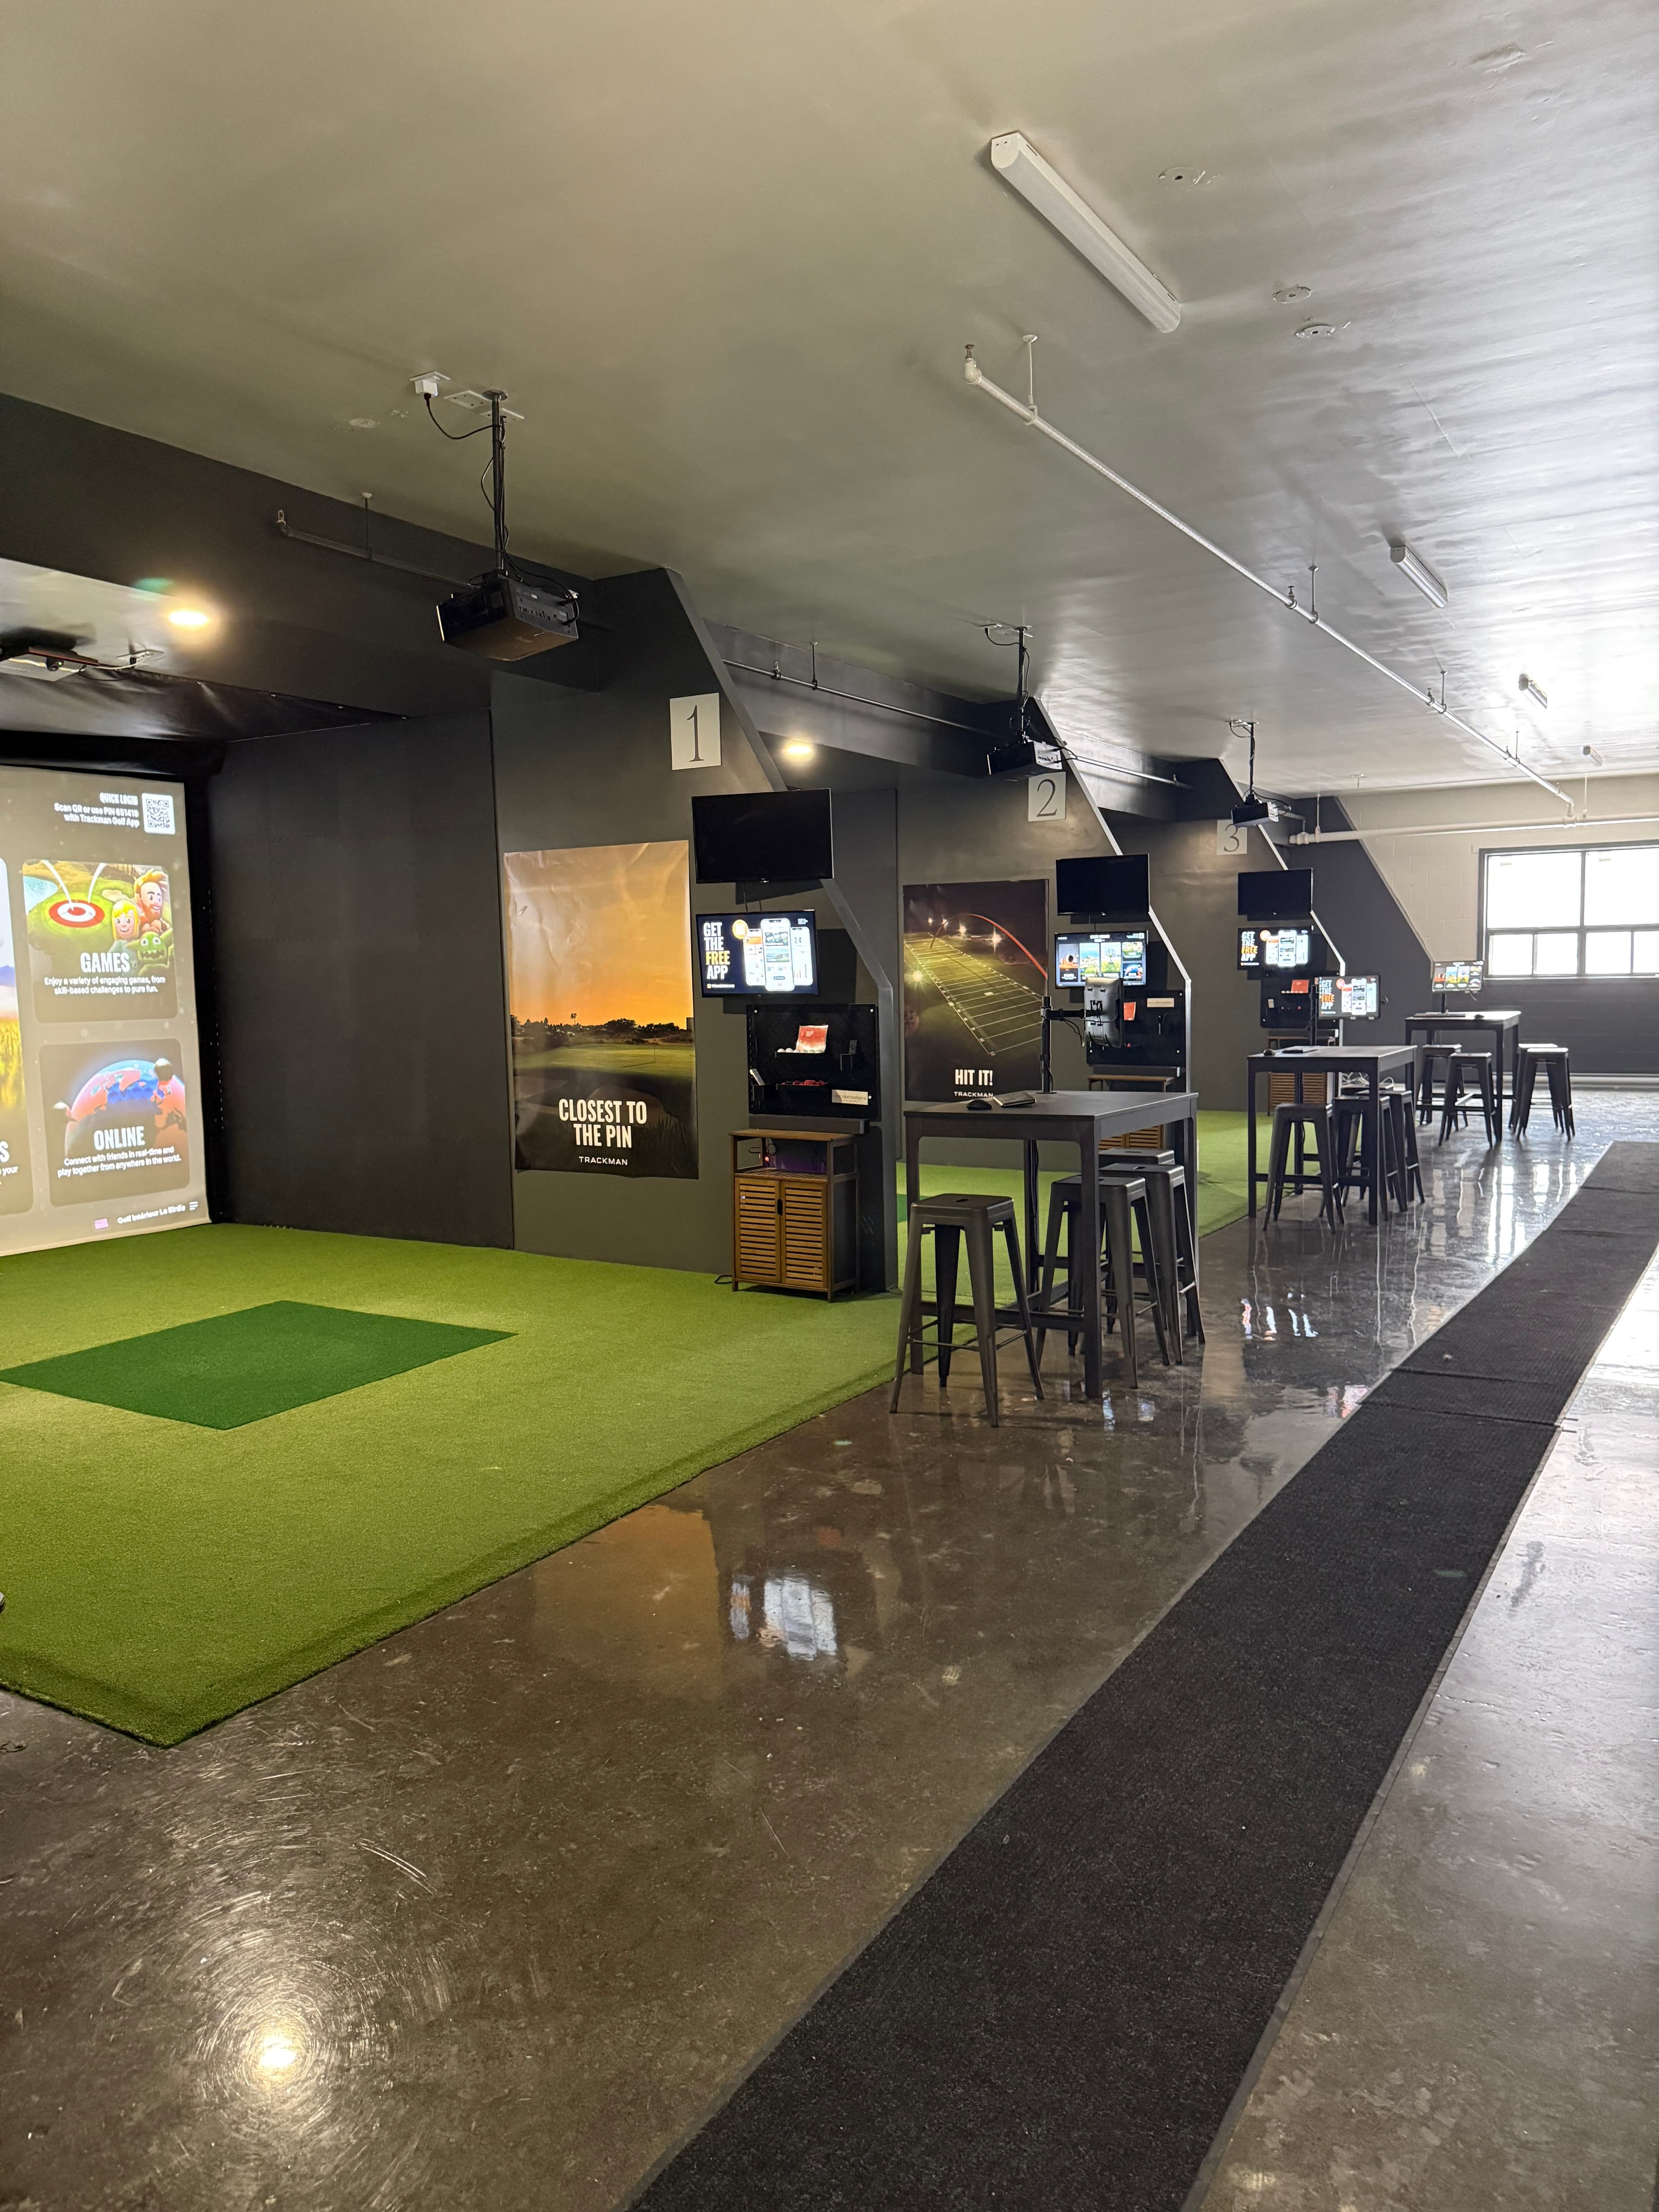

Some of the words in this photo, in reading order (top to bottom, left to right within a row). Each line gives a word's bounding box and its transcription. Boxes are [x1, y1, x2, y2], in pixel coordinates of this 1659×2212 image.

[686, 705, 704, 762] 1
[100, 792, 119, 804] QUICK
[120, 795, 138, 805] LOGIN
[1036, 779, 1057, 817] 2
[54, 803, 71, 812] Scan
[72, 804, 83, 813] QR
[83, 806, 91, 814] or
[91, 807, 103, 815] use
[104, 807, 115, 816] PIN
[64, 813, 79, 822] with
[80, 814, 112, 824] Trackman
[112, 816, 126, 826] Golf
[126, 819, 140, 828] App
[1224, 824, 1239, 852] 3
[703, 922, 723, 937] GET
[704, 936, 724, 951] THE
[80, 952, 130, 973] GAMES
[706, 951, 731, 965] FREE
[706, 965, 728, 979] APP
[44, 977, 62, 987] Enjoy
[69, 976, 91, 986] variety
[92, 976, 99, 984] of
[99, 976, 128, 985] engaging
[129, 976, 151, 985] games,
[151, 975, 166, 983] from
[54, 986, 90, 995] skill-based
[90, 986, 123, 995] challenges
[1321, 994, 1335, 1002] FREE
[1321, 1001, 1334, 1010] APP
[955, 1069, 975, 1085] HIT
[979, 1070, 993, 1086] IT!
[559, 1099, 622, 1123] CLOSEST
[626, 1101, 647, 1124] TO
[94, 1126, 145, 1150] ONLINE
[573, 1123, 602, 1147] THE
[606, 1125, 632, 1148] PIN
[64, 1157, 92, 1166] Connect
[92, 1154, 106, 1162] with
[106, 1152, 128, 1161] friends
[135, 1148, 162, 1157] real-time
[162, 1145, 175, 1154] and
[578, 1156, 628, 1166] TRACKMAN
[2, 1166, 19, 1176] your
[57, 1168, 72, 1178] play
[72, 1165, 100, 1176] together
[100, 1163, 115, 1171] from
[115, 1159, 145, 1170] anywhere
[152, 1156, 163, 1164] the
[163, 1154, 181, 1163] world.
[118, 1214, 131, 1224] Golf
